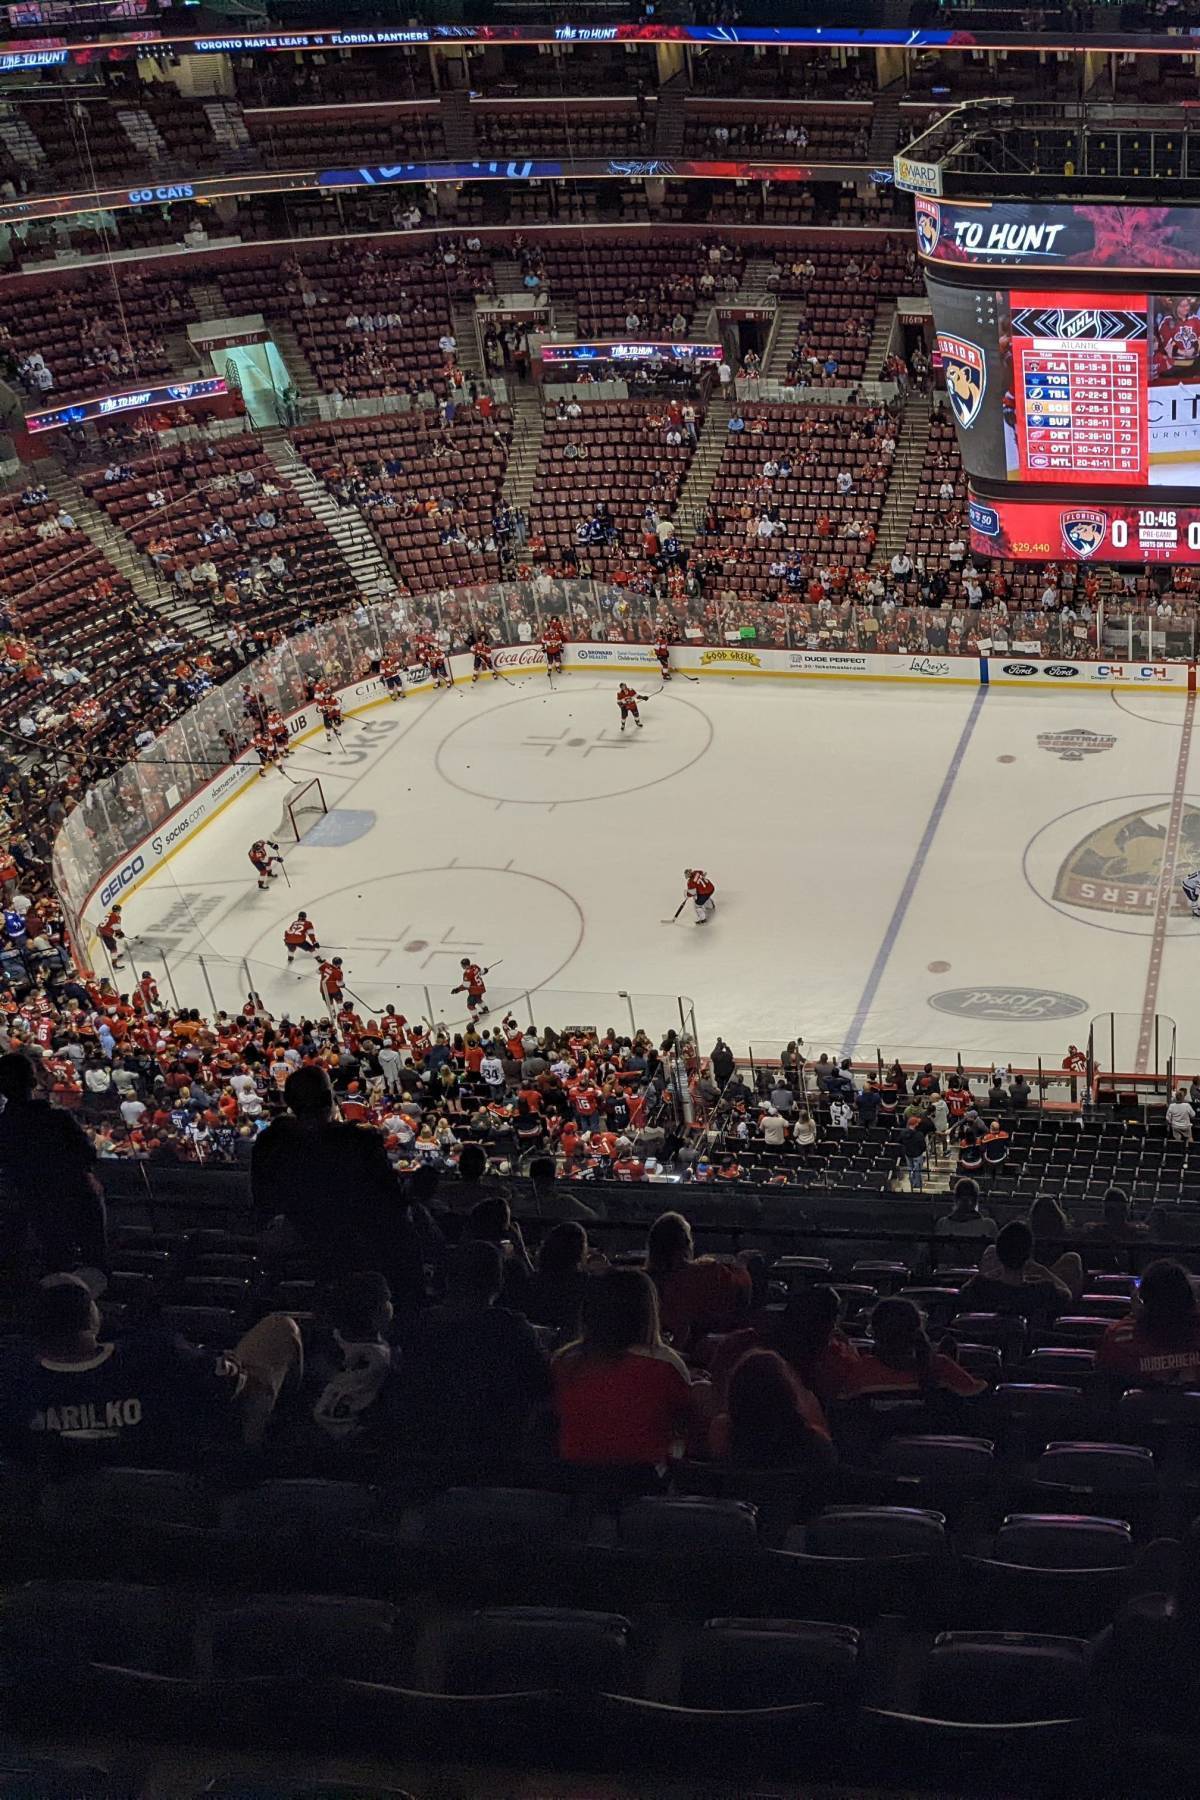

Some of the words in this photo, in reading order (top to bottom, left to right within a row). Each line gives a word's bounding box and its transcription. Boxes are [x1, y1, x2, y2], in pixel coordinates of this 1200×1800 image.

[555, 25, 576, 39] TIME
[578, 28, 590, 39] TO
[591, 27, 618, 39] HUNT
[195, 39, 242, 50] TORONTO
[244, 38, 277, 48] MAPLE
[279, 36, 308, 46] LEAFS
[332, 34, 375, 45] FLORIDA
[377, 32, 429, 43] PANTHERS
[38, 50, 66, 65] HUNT
[129, 187, 153, 203] GO
[155, 184, 193, 201] CATS
[953, 221, 983, 248] TO
[986, 221, 1067, 252] HUNT
[1066, 311, 1093, 337] NHL
[1061, 341, 1098, 350] ATLANTIC
[1047, 362, 1067, 371] FLA
[1047, 376, 1068, 385] TOR
[1048, 390, 1068, 399] TBL
[1049, 417, 1069, 426] BUF
[1120, 419, 1131, 427] 73
[1050, 431, 1070, 439] DET
[1050, 444, 1070, 452] OTT
[1050, 458, 1071, 466] MTL
[981, 514, 992, 526] 50
[1066, 513, 1100, 522] FLORIDA
[1137, 510, 1177, 528] 10:46
[1112, 520, 1127, 547] 0
[1142, 530, 1173, 539] PRE-GAME
[1012, 542, 1050, 553] $29,440
[706, 651, 728, 662] GOOD
[729, 651, 755, 663] GREEK
[829, 656, 867, 664] PERFECT
[910, 657, 950, 675] LaCroix
[1007, 664, 1033, 676] Ford
[1048, 666, 1075, 677] Ford
[1097, 665, 1123, 678] CH
[1140, 666, 1166, 678] CH
[100, 855, 145, 908] GEICO
[960, 991, 1057, 1017] Ford
[484, 1069, 498, 1081] 34
[172, 1118, 183, 1129] 91
